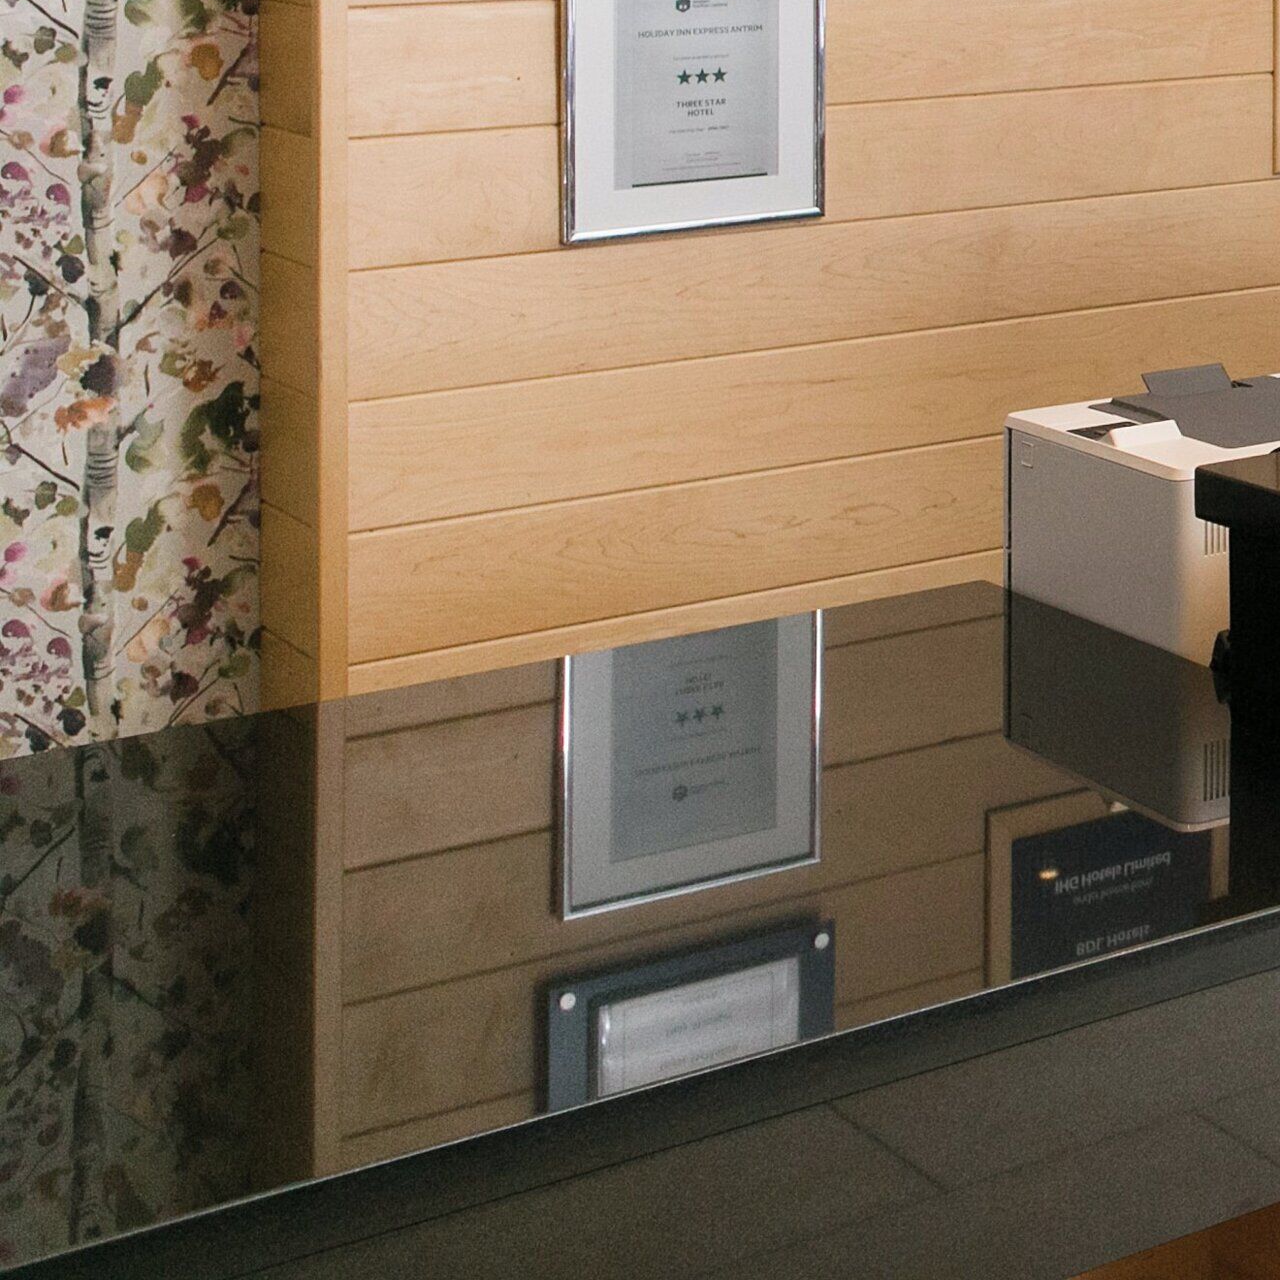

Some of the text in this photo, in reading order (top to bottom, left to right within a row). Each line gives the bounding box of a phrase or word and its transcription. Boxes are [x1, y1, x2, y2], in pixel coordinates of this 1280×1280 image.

[638, 24, 763, 39] HOLIDAY INN EXPRESS ANTRIM
[677, 98, 727, 108] THREE STAR
[688, 109, 714, 117] HOTEL
